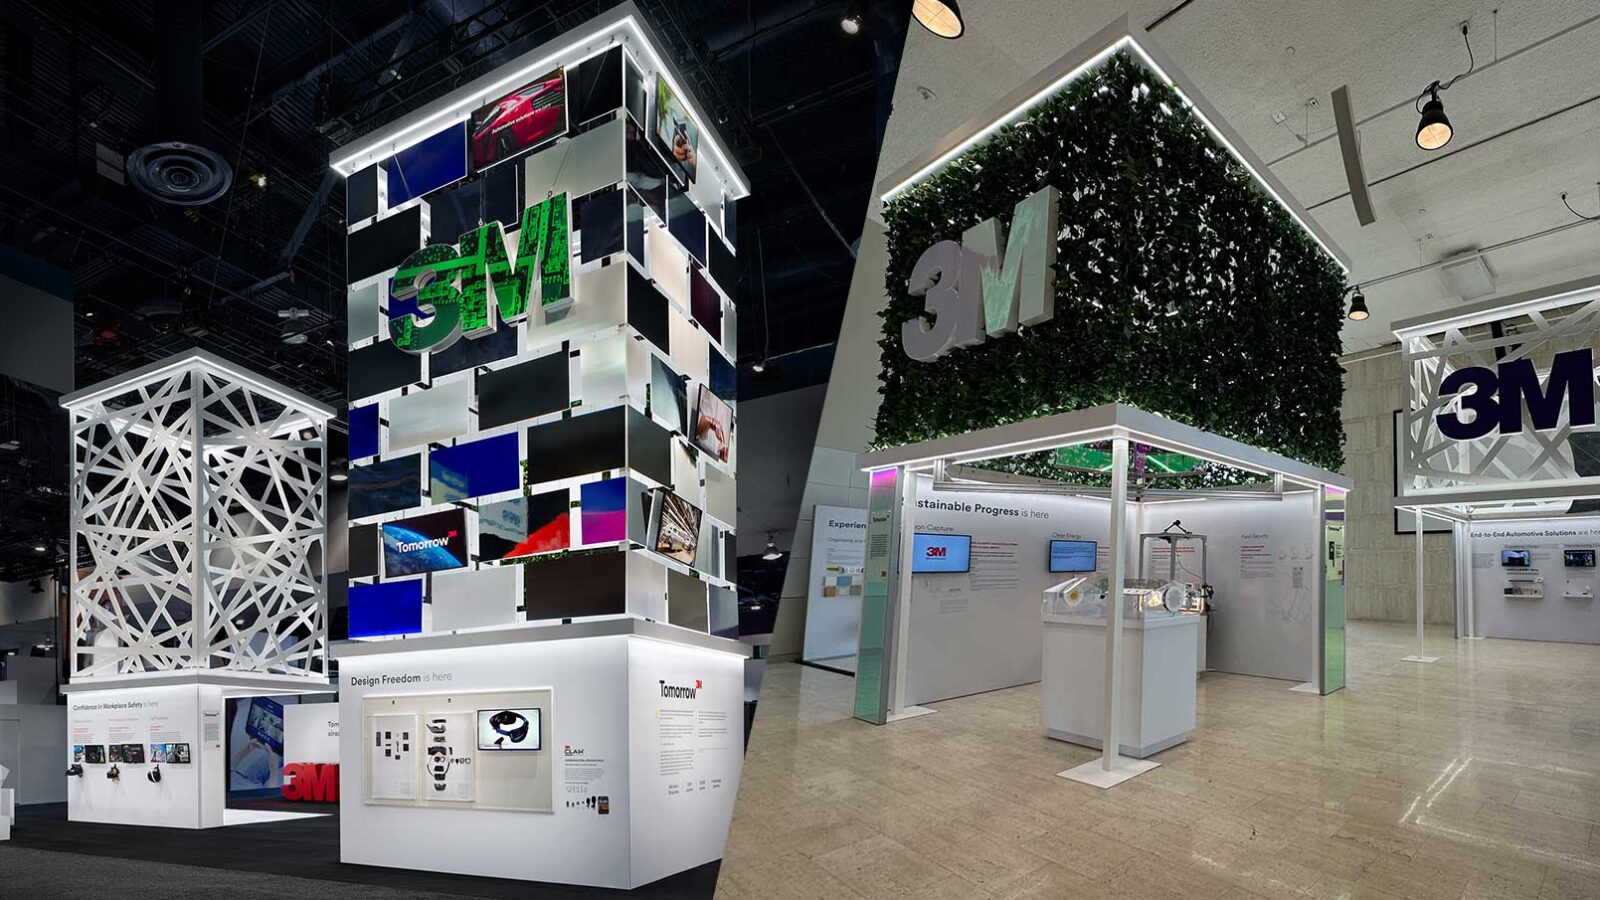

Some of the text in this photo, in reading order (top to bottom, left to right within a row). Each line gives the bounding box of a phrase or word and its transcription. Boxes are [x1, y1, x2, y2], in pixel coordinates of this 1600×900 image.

[516, 111, 535, 122] solutions
[388, 190, 575, 355] 3M
[902, 185, 1059, 363] 3M
[1435, 348, 1596, 441] 3M
[901, 496, 1049, 519] stainable Progress is here
[926, 523, 954, 532] Capture
[396, 537, 449, 553] Tomorrow
[926, 546, 947, 557] 3M
[351, 672, 452, 687] Design Freedom is here
[659, 680, 696, 699] Tomorrow
[282, 762, 339, 803] 3M
